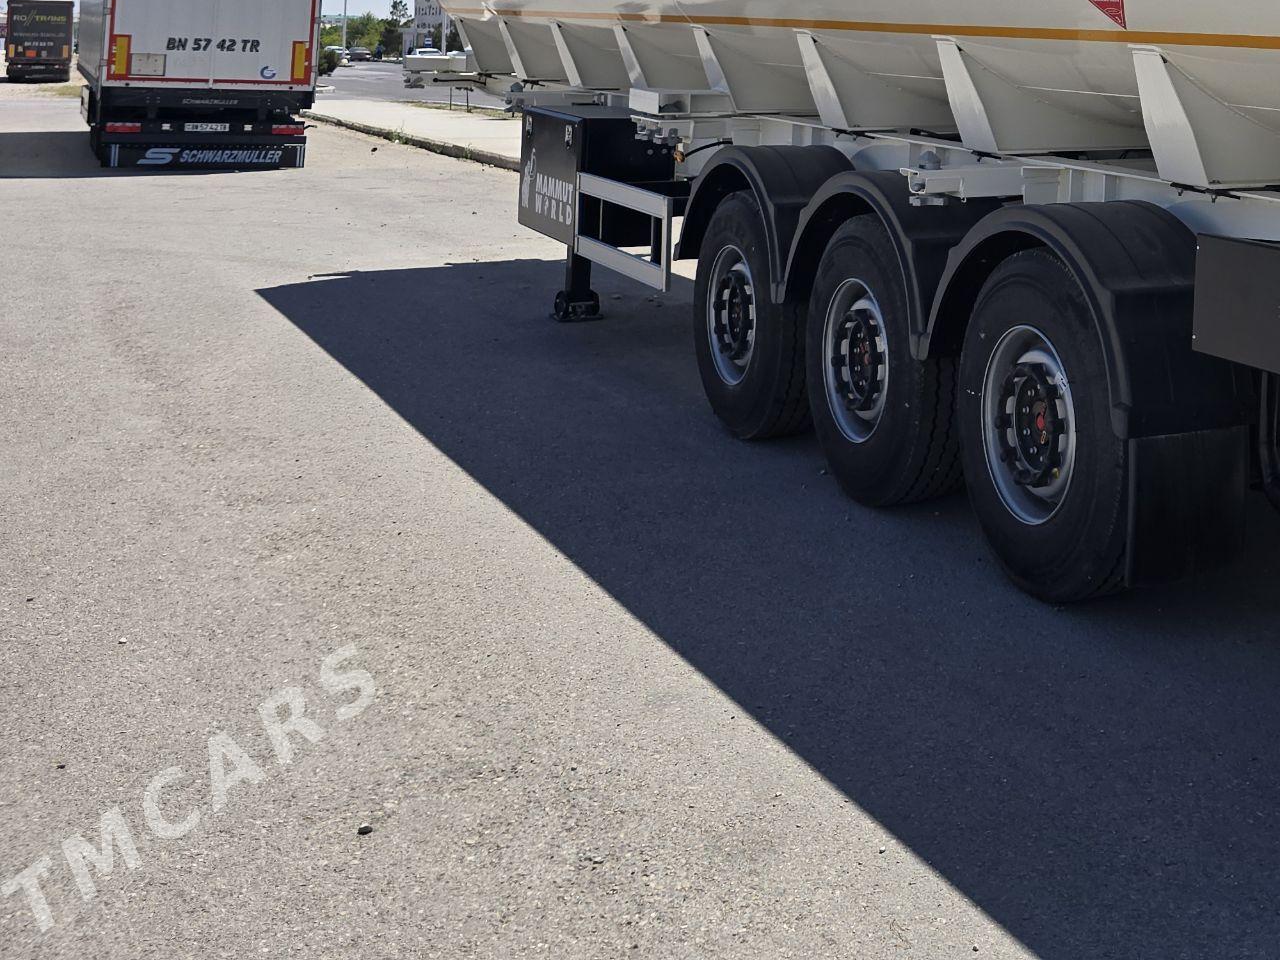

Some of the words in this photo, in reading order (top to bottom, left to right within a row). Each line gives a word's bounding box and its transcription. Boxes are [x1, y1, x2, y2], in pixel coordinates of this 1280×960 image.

[166, 37, 189, 51] BN
[191, 38, 212, 52] 57
[216, 38, 237, 52] 42
[241, 39, 261, 53] TR
[535, 172, 574, 204] MAMMUT
